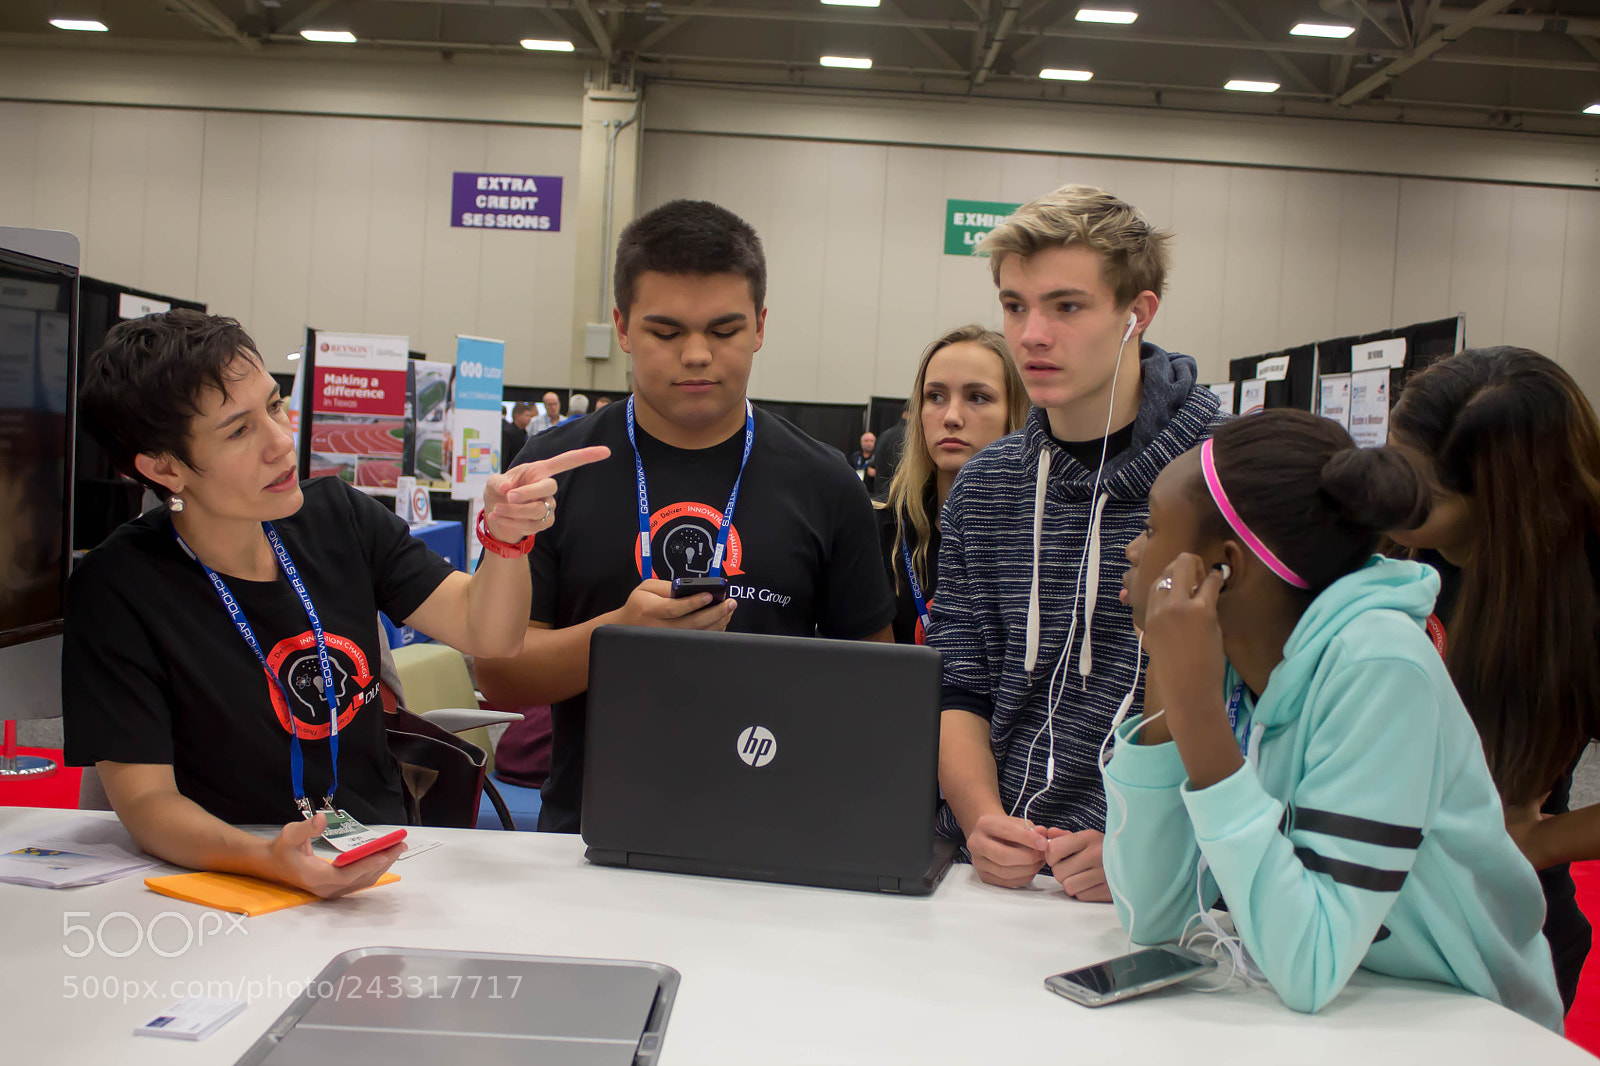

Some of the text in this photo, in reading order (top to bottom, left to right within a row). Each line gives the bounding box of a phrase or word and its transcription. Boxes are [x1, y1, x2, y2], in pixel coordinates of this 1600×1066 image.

[477, 176, 538, 192] EXTRA
[475, 194, 539, 211] CREDIT
[462, 212, 551, 230] SESSIONS
[324, 373, 379, 389] Making a
[323, 384, 385, 399] difference
[208, 572, 238, 621] SCHOOL
[729, 585, 791, 607] DLR Group
[343, 641, 369, 680] CHALLENGE
[741, 726, 773, 767] hp
